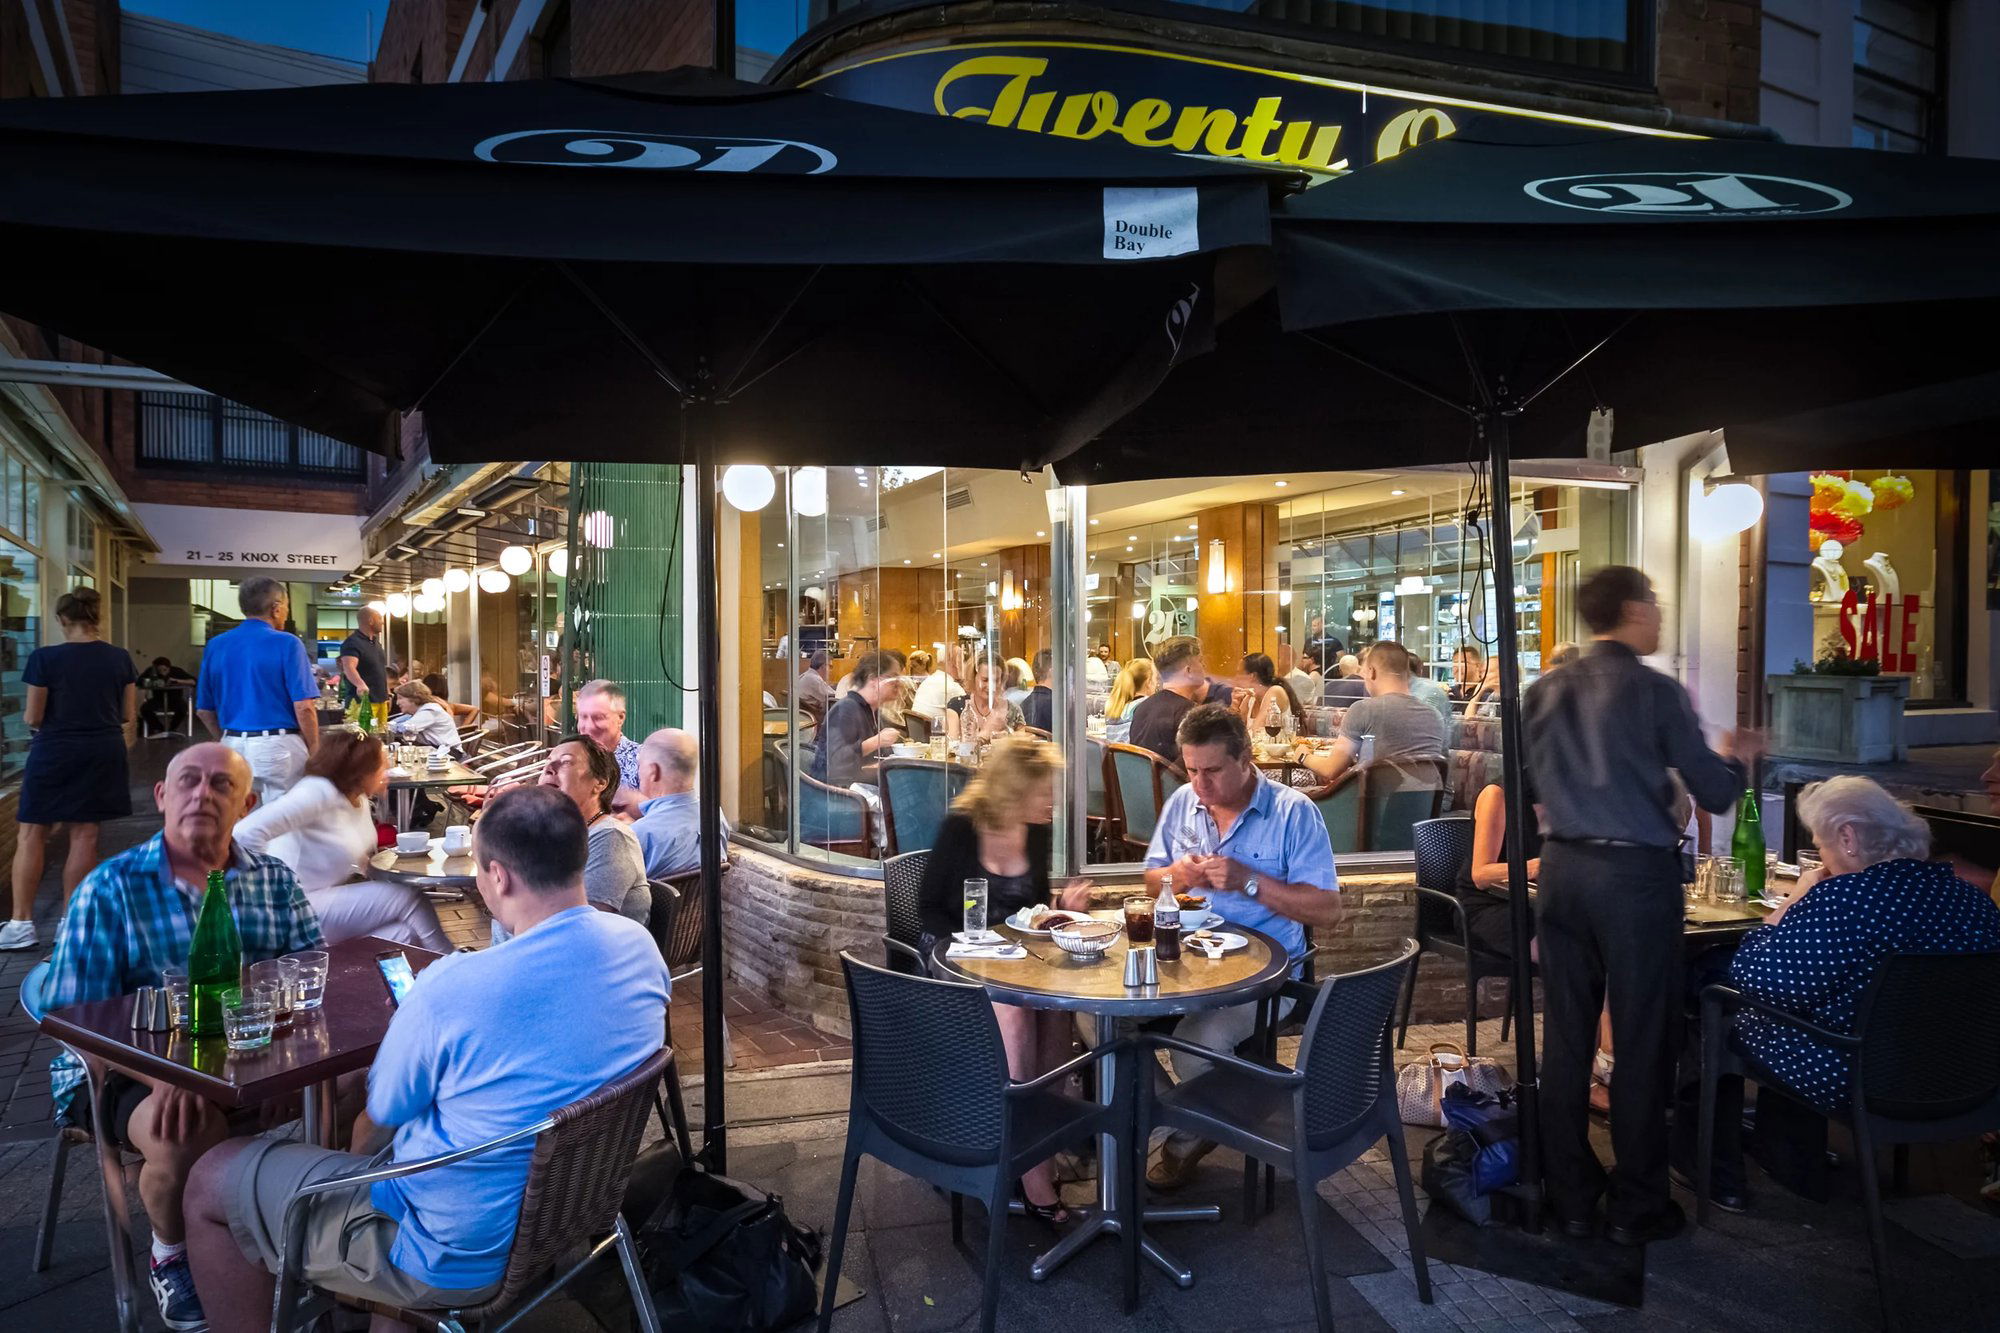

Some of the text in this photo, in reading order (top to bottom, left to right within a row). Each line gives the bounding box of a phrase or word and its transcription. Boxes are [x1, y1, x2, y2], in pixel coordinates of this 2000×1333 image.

[1568, 175, 1801, 212] 21
[1115, 220, 1173, 240] Double
[1114, 235, 1146, 255] Bay
[186, 550, 201, 560] 21
[218, 551, 234, 561] 25
[241, 552, 279, 563] KNOX
[287, 553, 338, 565] STREET
[1840, 590, 1919, 672] SALE
